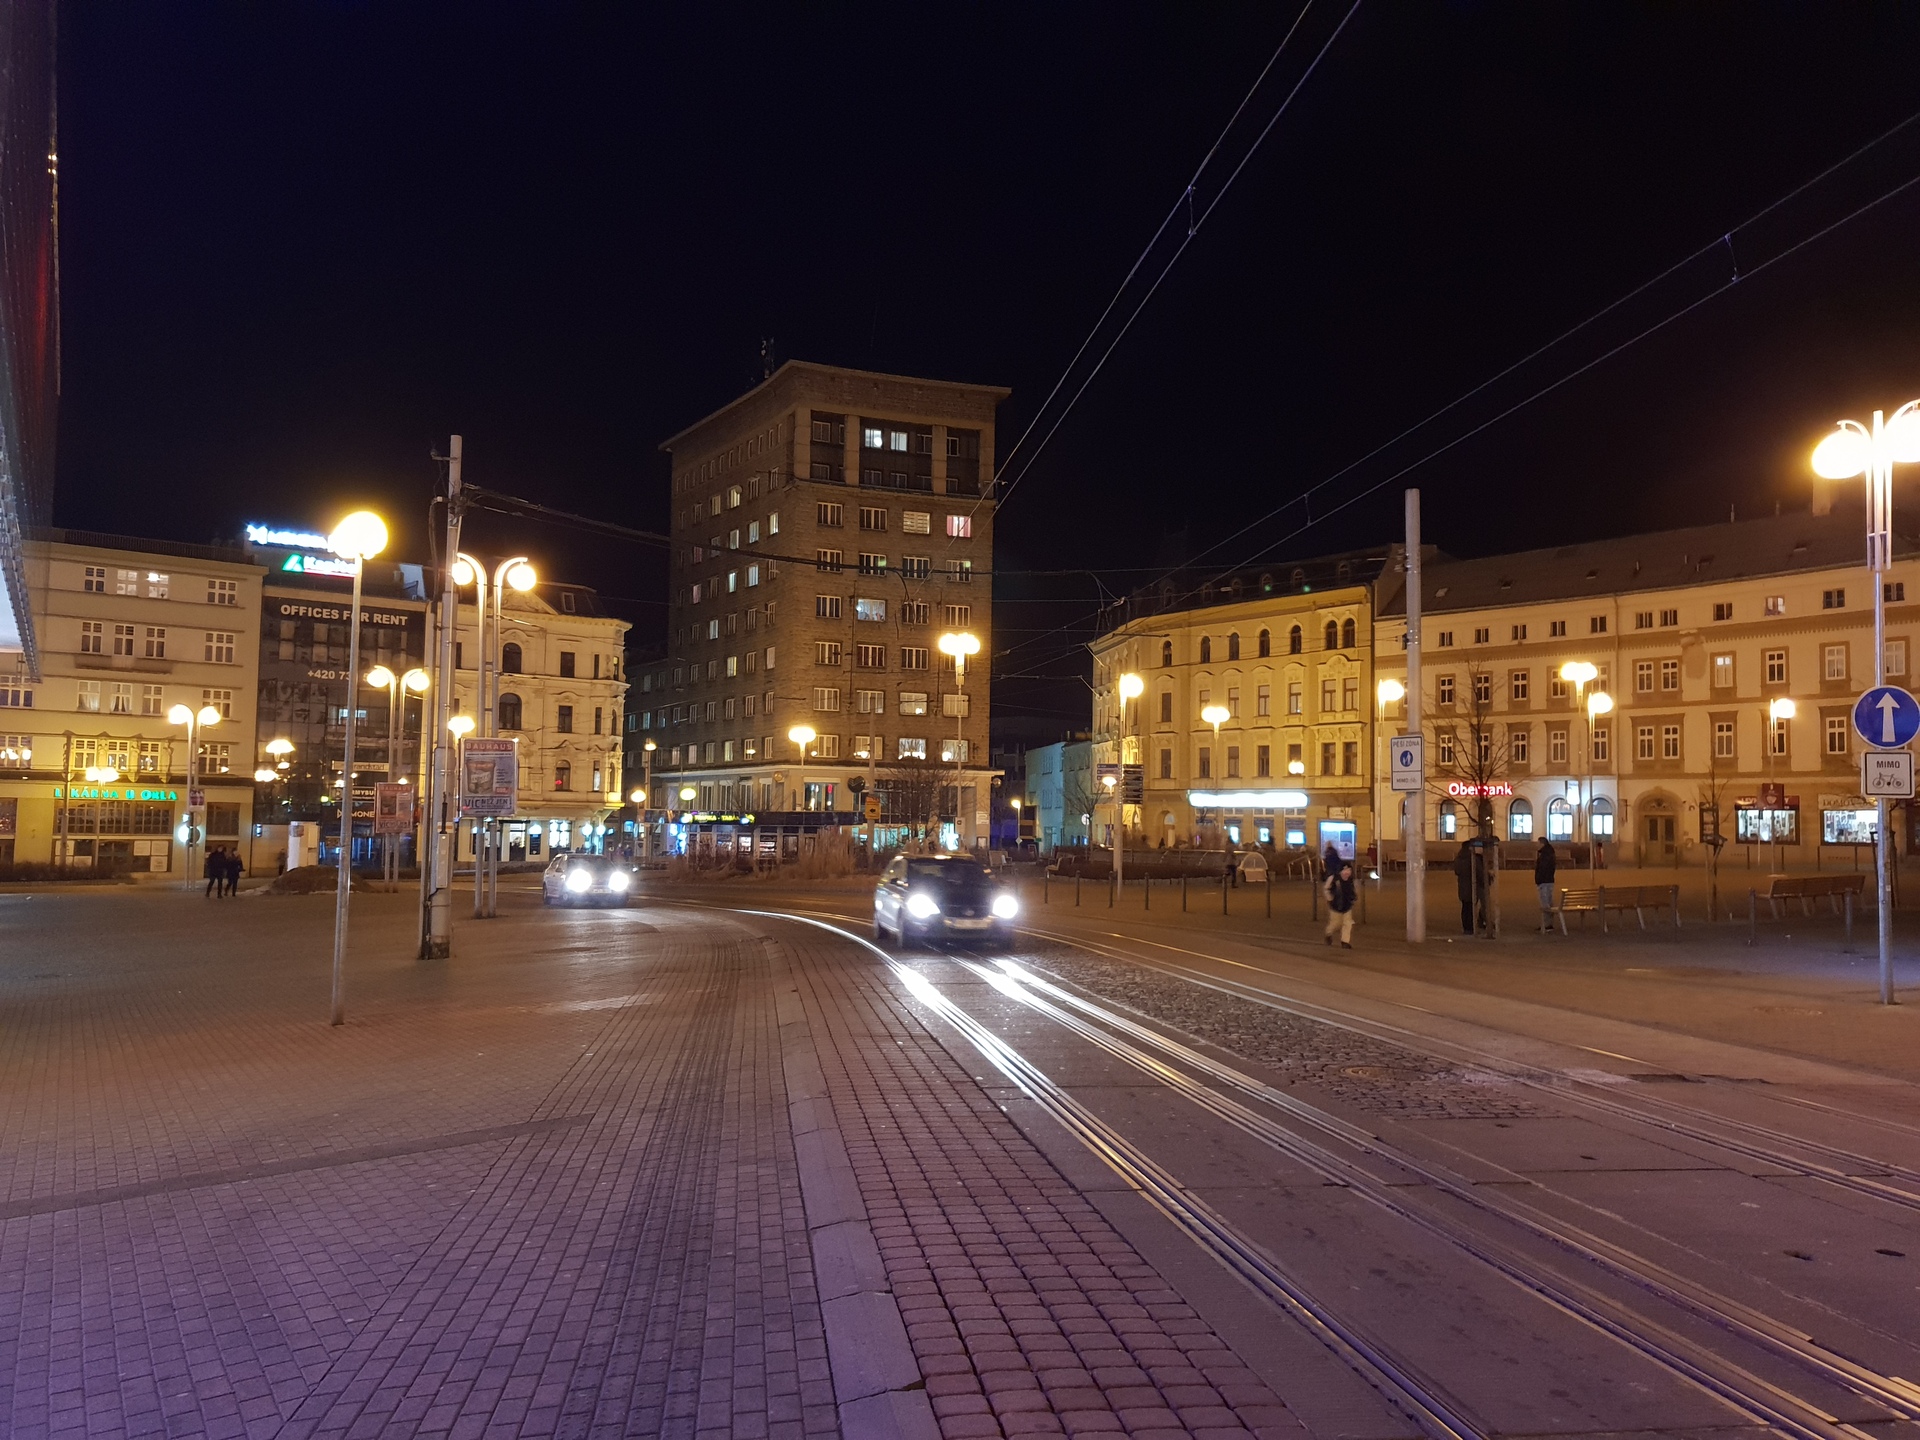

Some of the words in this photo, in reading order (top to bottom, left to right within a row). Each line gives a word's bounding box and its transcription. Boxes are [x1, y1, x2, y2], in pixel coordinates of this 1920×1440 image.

[280, 604, 339, 620] OFFICES
[343, 610, 370, 623] FR
[373, 613, 408, 626] RENT
[308, 670, 336, 680] +420
[465, 742, 513, 751] BAUHAUS
[1876, 760, 1901, 769] MIMO
[125, 789, 135, 800] U
[351, 810, 375, 818] MONE
